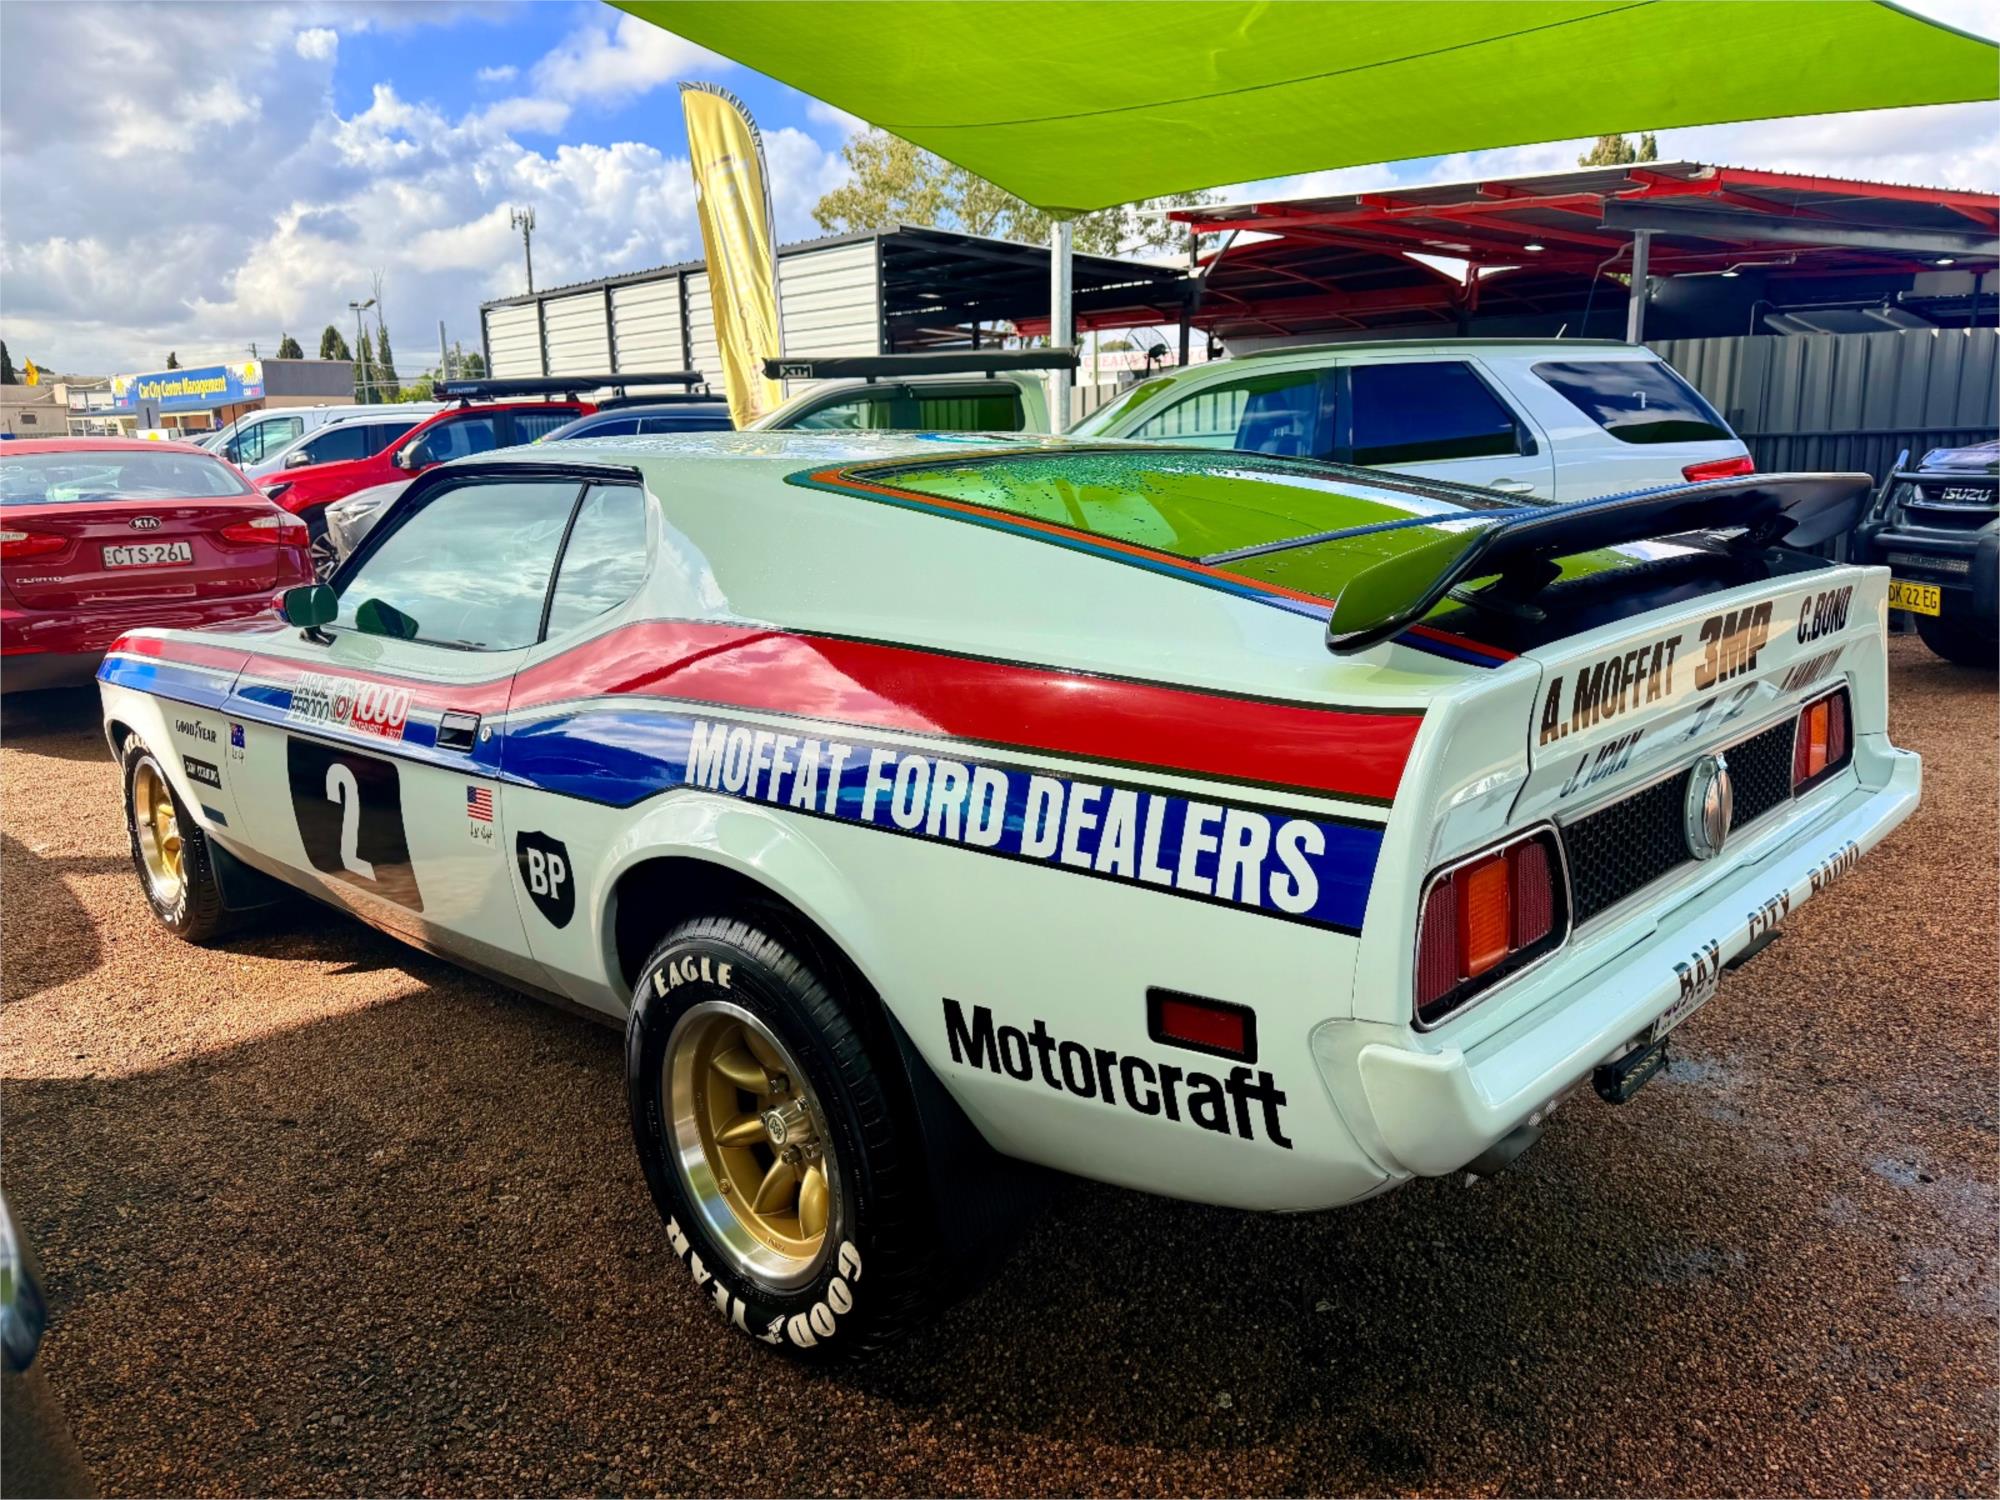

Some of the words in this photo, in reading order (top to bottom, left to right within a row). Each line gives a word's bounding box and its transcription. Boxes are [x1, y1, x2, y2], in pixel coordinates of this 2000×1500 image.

[138, 382, 150, 399] Car
[149, 380, 162, 402] City
[161, 379, 182, 397] Centre
[182, 375, 227, 400] Management
[782, 365, 811, 378] XTM
[1942, 487, 1992, 501] ISUZU
[134, 518, 157, 529] KIA
[1906, 588, 1920, 607] 22
[1923, 590, 1937, 609] EG
[1540, 635, 1683, 745] A.MOFFAT
[1695, 601, 1773, 690] 3MP
[1797, 585, 1852, 644] C.BOND
[354, 682, 409, 727] 1000
[326, 762, 376, 881] 2
[686, 720, 852, 801] MOFFAT
[861, 746, 1009, 846] FORD
[1020, 773, 1326, 914] DEALERS
[527, 847, 566, 899] BP
[1747, 888, 1789, 943] CITY
[1807, 840, 1859, 896] RADIO
[653, 955, 733, 998] EAGLE
[942, 998, 1294, 1149] Motorcraft
